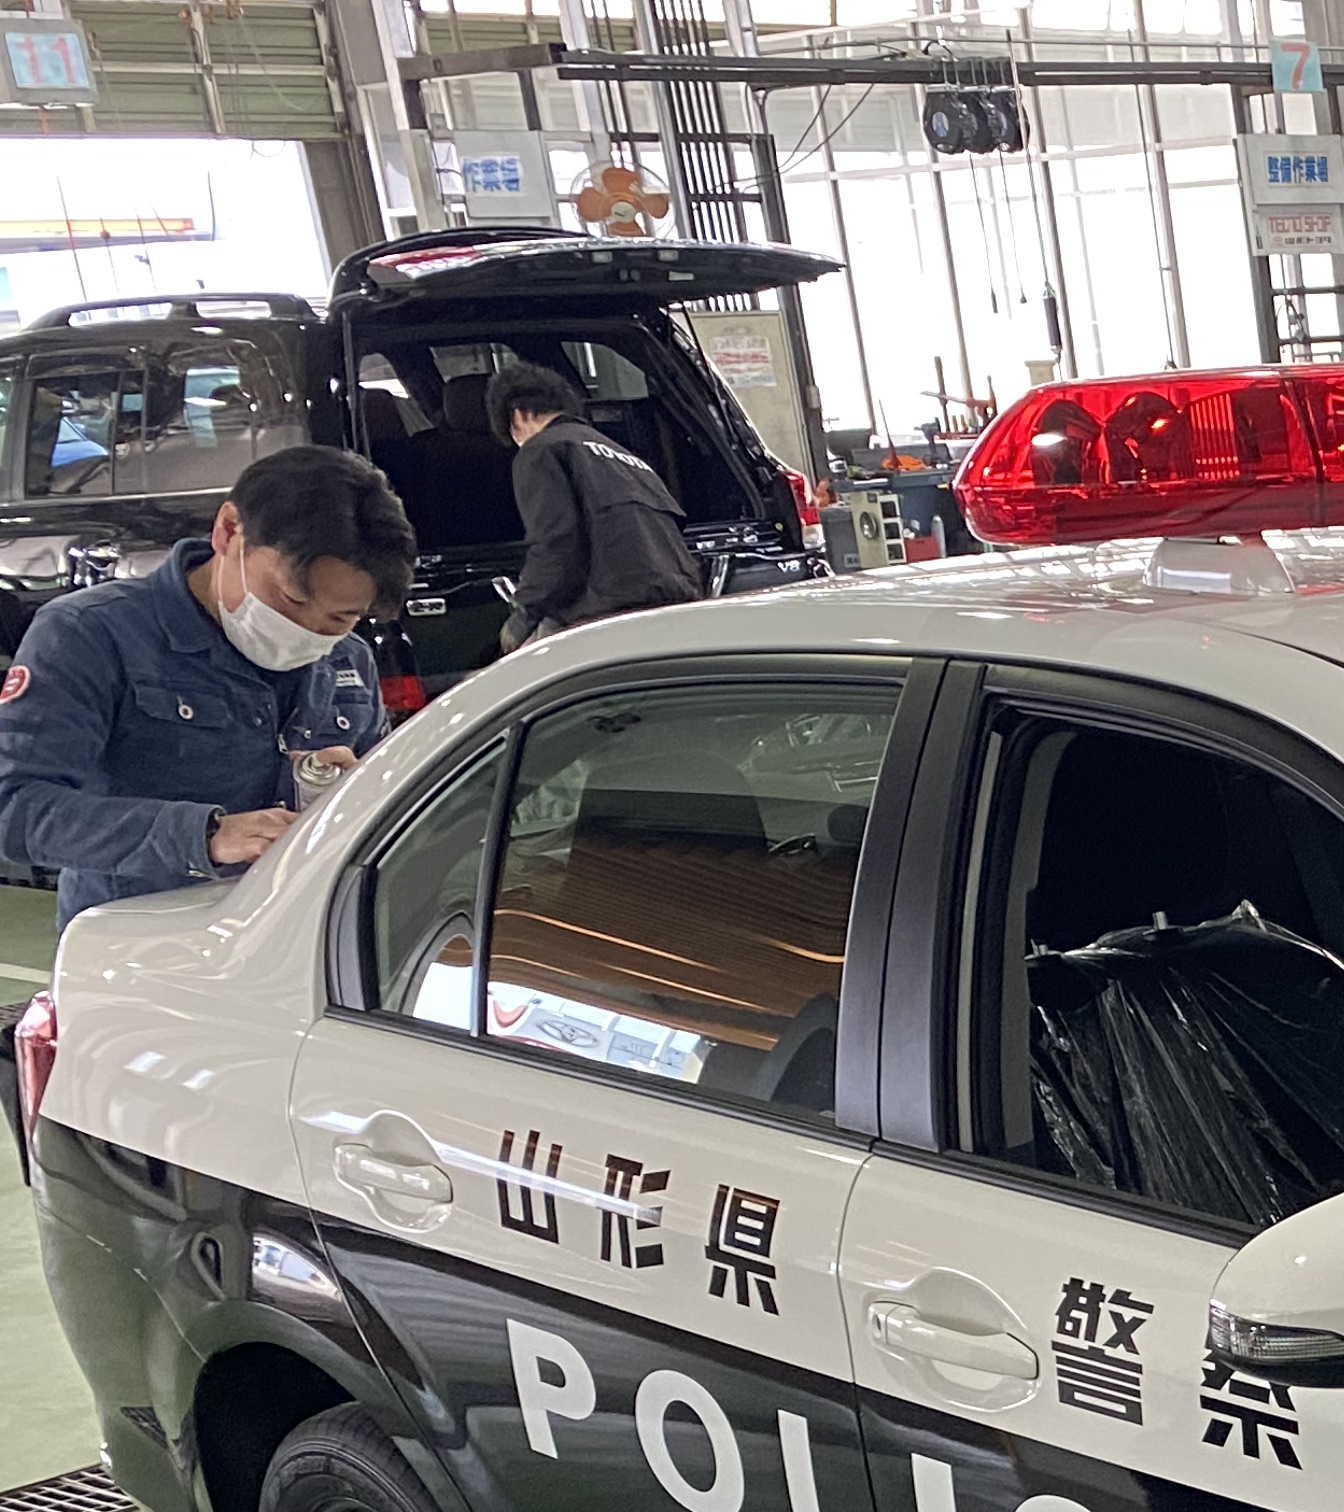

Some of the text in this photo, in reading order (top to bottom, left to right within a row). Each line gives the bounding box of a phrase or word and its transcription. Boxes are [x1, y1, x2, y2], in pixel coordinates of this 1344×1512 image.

[1280, 43, 1310, 90] 7
[497, 1129, 781, 1316] 山形県
